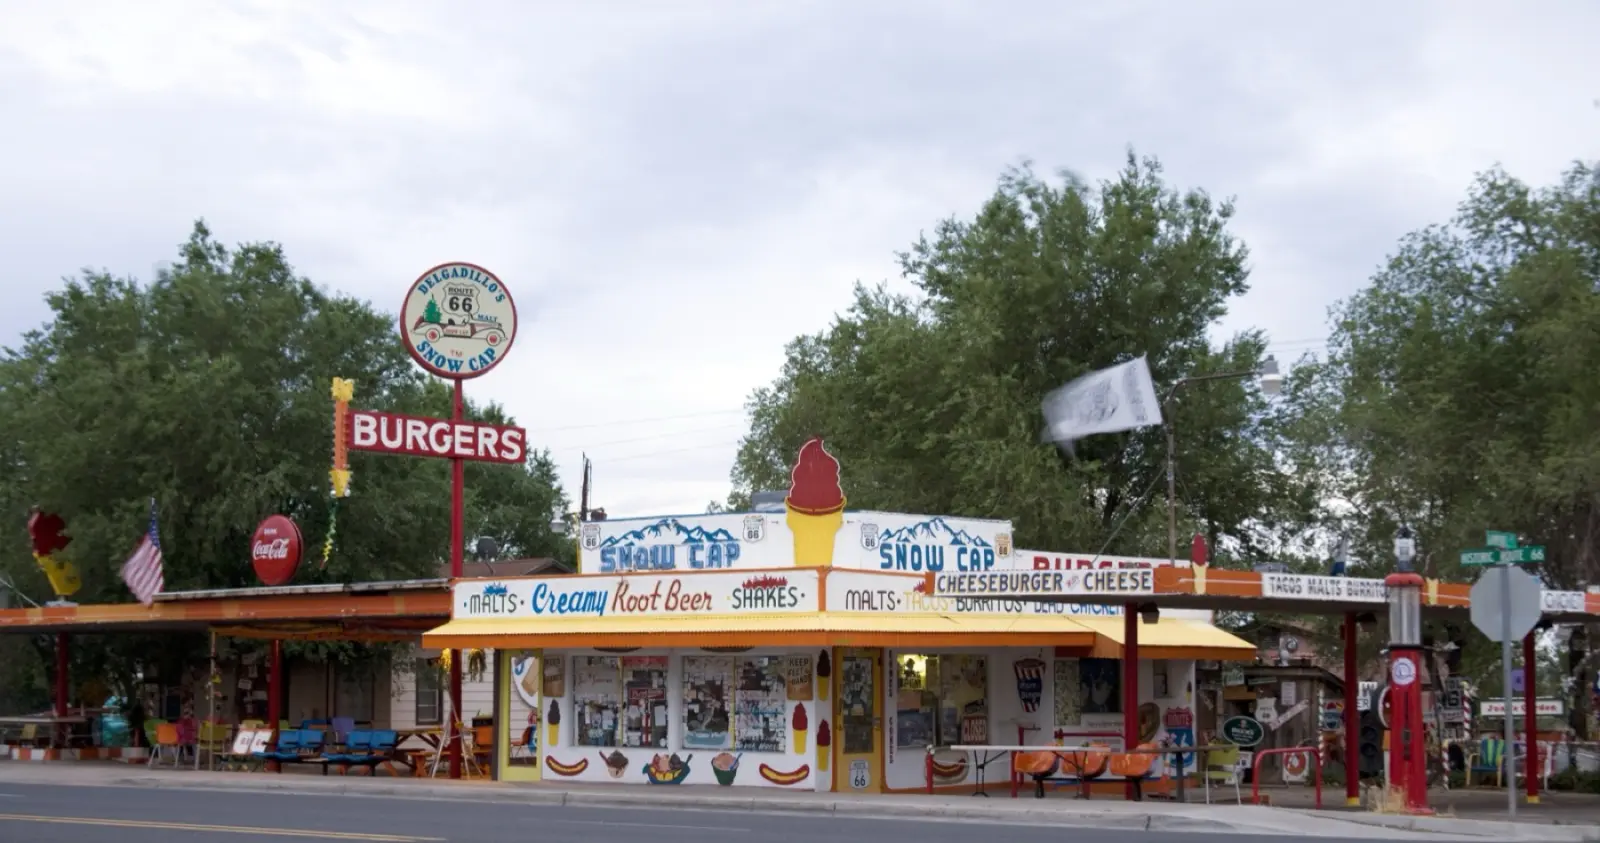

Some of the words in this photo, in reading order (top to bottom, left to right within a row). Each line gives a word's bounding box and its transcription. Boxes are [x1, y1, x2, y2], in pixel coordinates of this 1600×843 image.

[418, 267, 506, 303] DELGADILLO'S
[448, 286, 474, 296] ROUTE
[449, 296, 472, 313] 66
[417, 340, 464, 373] SNOW
[468, 347, 497, 371] CAP
[353, 414, 522, 461] BURGERS
[747, 530, 760, 539] 66
[865, 538, 875, 548] 66
[253, 538, 290, 560] Coca-Cola
[600, 545, 676, 573] SNOW
[688, 542, 741, 569] CAP
[880, 543, 944, 572] SNOW
[957, 547, 995, 571] CAP
[1531, 548, 1545, 560] 66
[937, 573, 1063, 593] CHEESEBURGER
[1083, 571, 1152, 591] CHEESE
[1269, 576, 1301, 594] TACOS
[1307, 578, 1342, 596] MALTS
[469, 593, 518, 614] MALTS
[532, 583, 609, 617] Creamy
[611, 580, 662, 613] Root
[664, 578, 713, 612] Beer
[732, 586, 798, 609] SHAKES
[845, 589, 896, 611] MALTS
[905, 592, 948, 612] TACOS
[789, 658, 809, 667] KEEP
[963, 718, 987, 741] CLOSED
[1168, 713, 1190, 725] ROUTE
[854, 776, 866, 787] 66
